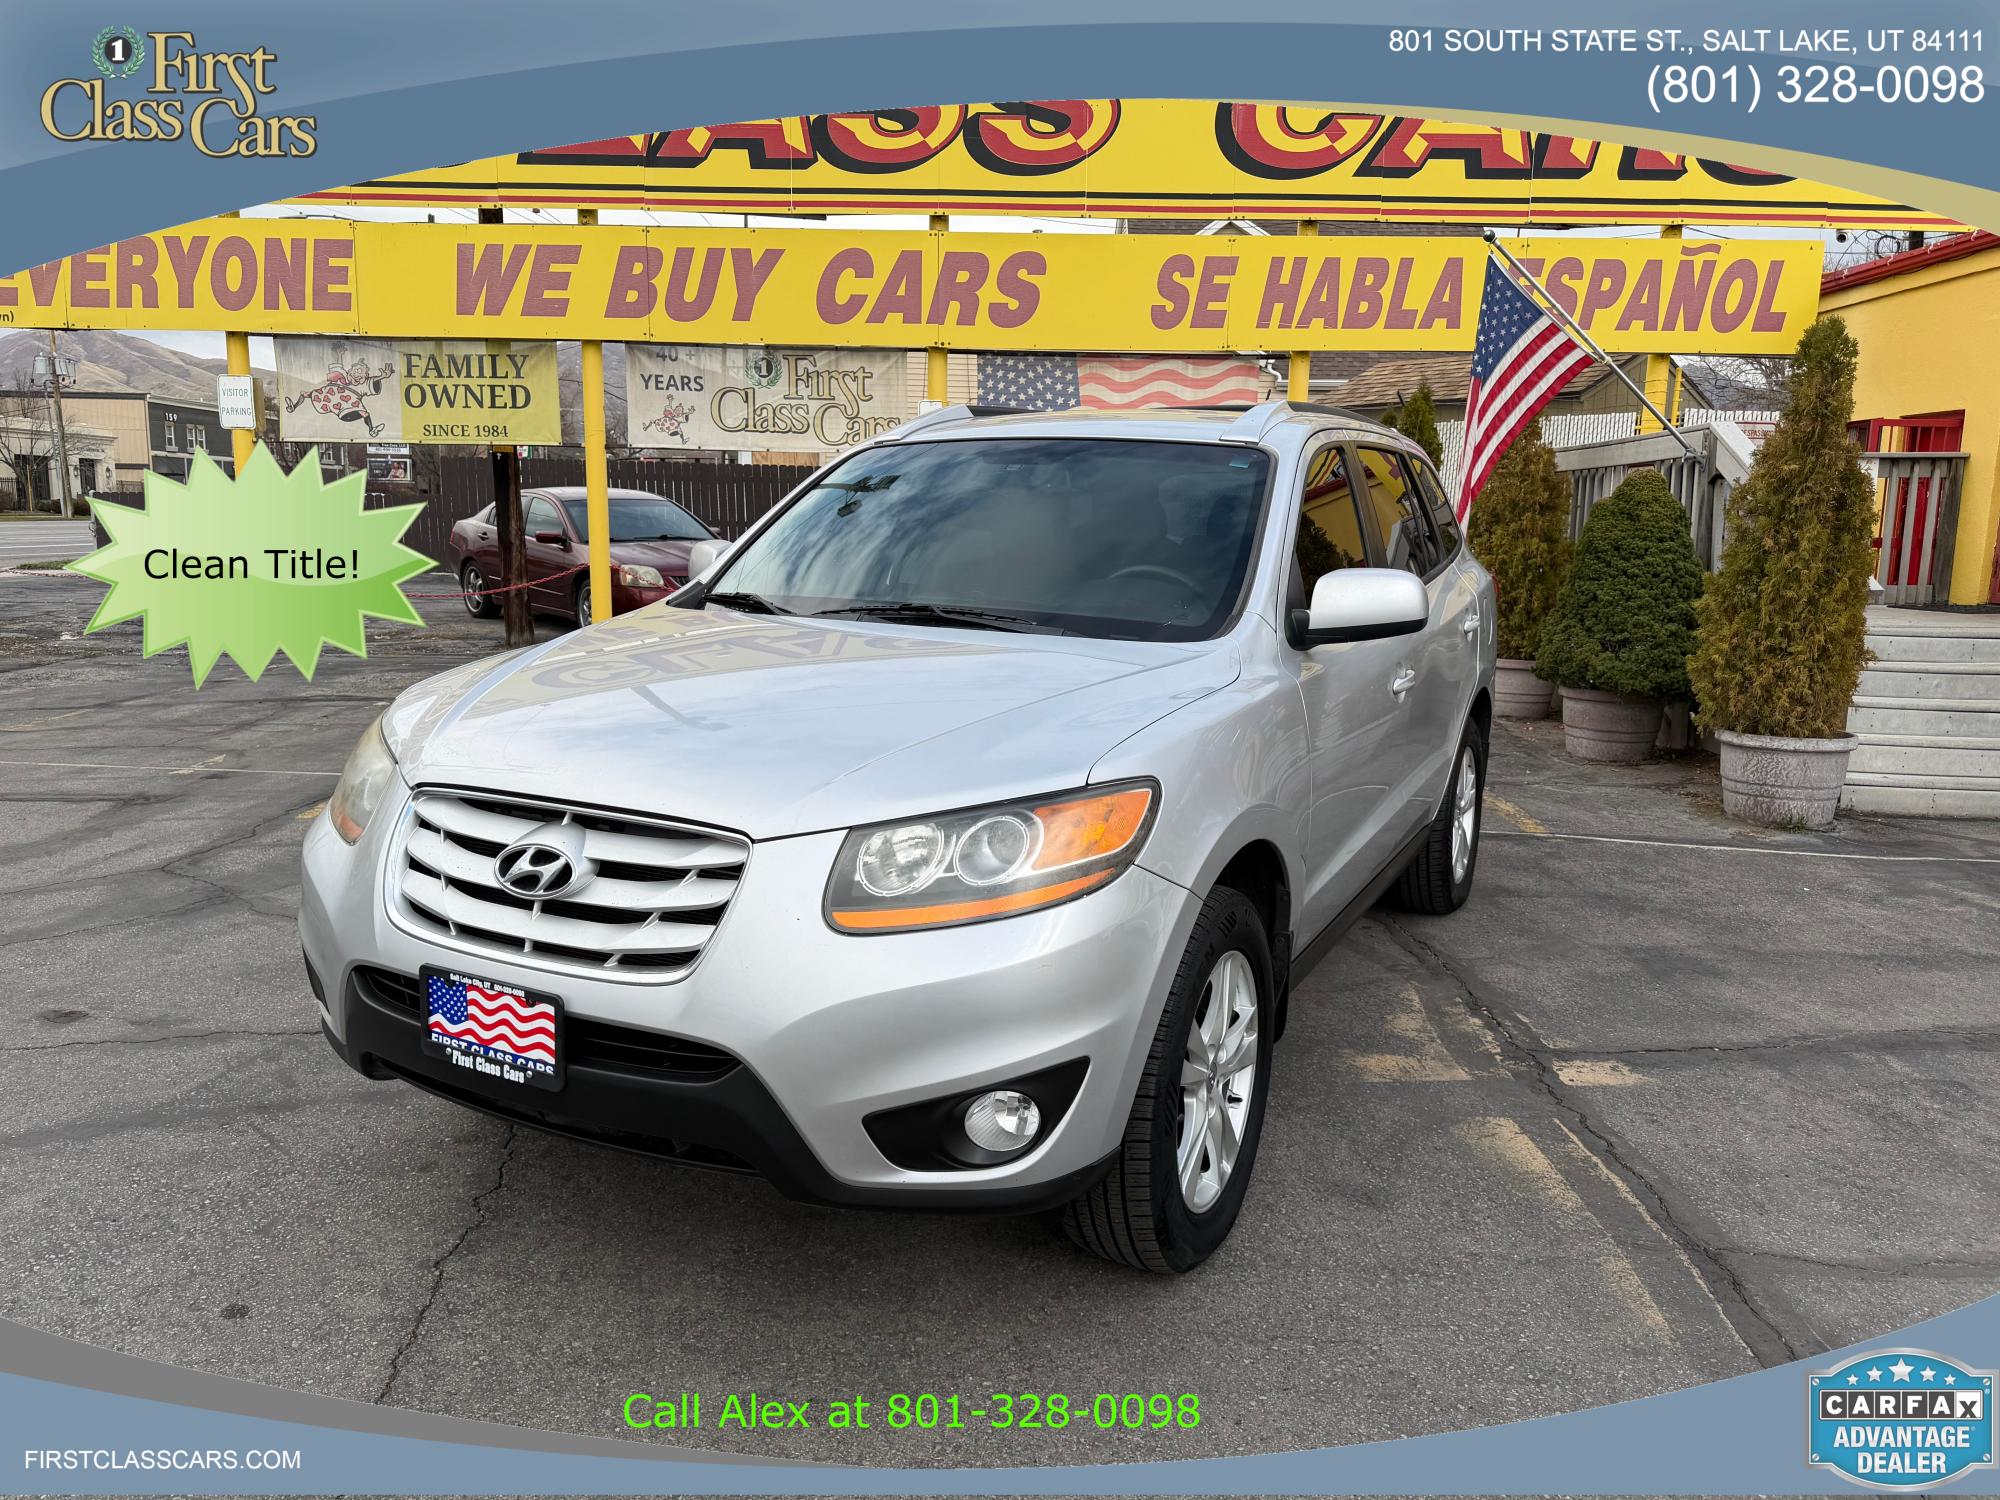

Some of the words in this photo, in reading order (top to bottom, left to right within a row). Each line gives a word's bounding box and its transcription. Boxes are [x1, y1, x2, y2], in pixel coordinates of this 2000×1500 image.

[455, 243, 582, 317] WE
[604, 245, 786, 321] BUY
[815, 247, 1047, 328] CARS
[1150, 253, 1240, 330] SE
[1256, 255, 1463, 330] HABLA
[403, 353, 529, 379] FAMILY
[656, 346, 679, 362] 40
[222, 388, 248, 397] VISITOR
[640, 373, 704, 392] YEARS
[783, 354, 873, 417] First
[404, 383, 531, 409] OWNED
[165, 412, 178, 421] 159
[221, 407, 251, 416] PARKING
[710, 386, 808, 433] Class
[423, 424, 470, 437] SINCE
[475, 424, 509, 438] 1984
[452, 1049, 474, 1069] First
[475, 1056, 501, 1077] Class
[503, 1064, 525, 1083] Cars
